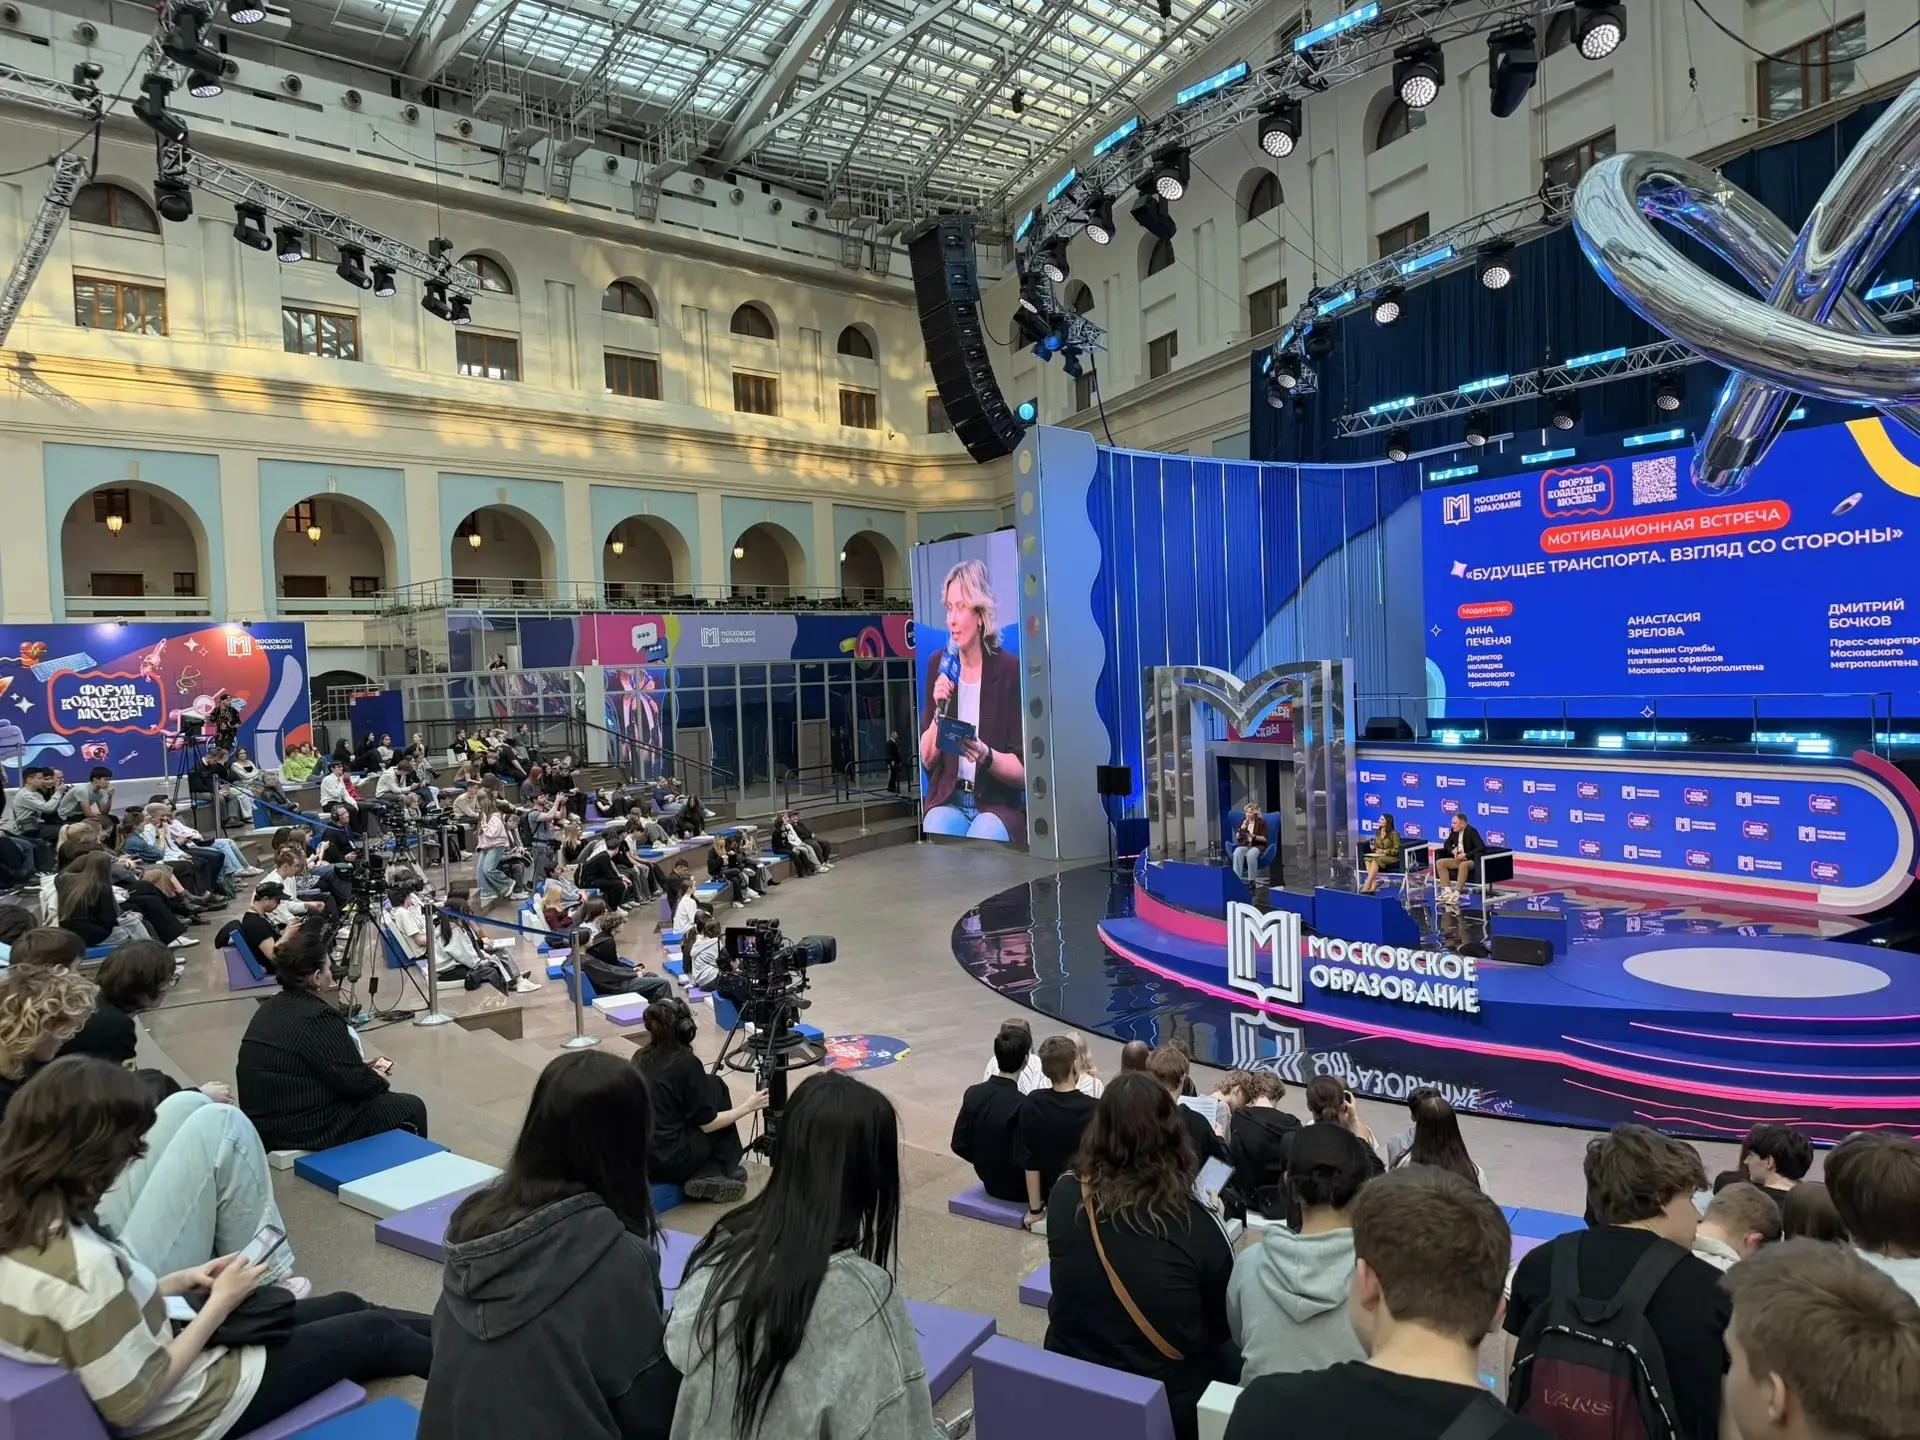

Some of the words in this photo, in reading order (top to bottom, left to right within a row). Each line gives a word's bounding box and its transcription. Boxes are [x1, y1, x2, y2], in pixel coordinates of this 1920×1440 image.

[1559, 476, 1593, 488] ФОРУМ
[1548, 481, 1606, 499] КОЛЛЕДЖЕЙ
[1474, 491, 1521, 505] МОСКОВСКОЕ
[1557, 494, 1596, 507] МОСКВЫ
[1474, 501, 1521, 514] ОБРАЗОВАНИЕ
[1547, 517, 1694, 546] МОТИВАЦИОННАЯ
[1700, 508, 1780, 529] ВСТРЕЧА
[1465, 559, 1545, 581] «БУДУЩЕЕ
[1549, 550, 1665, 574] ТРАНСПОРТА.
[1671, 542, 1743, 563] ВЗГЛЯД
[1748, 539, 1775, 554] СО
[1782, 527, 1904, 551] СТОРОНЫ»
[1462, 604, 1508, 615] Модератор:
[1828, 598, 1905, 616] ДМИТРИЙ
[1627, 612, 1701, 626] АНАСТАСИЯ
[1829, 615, 1892, 628] БОЧКОВ
[1465, 625, 1493, 636] АННА
[1627, 626, 1684, 638] ЗРЕЛОВА
[1466, 635, 1512, 647] ПЕЧЕНАЯ
[1830, 637, 1920, 648] Пресс-секретар
[1627, 646, 1676, 655] Начальник
[1677, 644, 1715, 655] Службы
[1830, 648, 1904, 658] Московского
[1467, 653, 1503, 663] Директор
[1628, 656, 1677, 665] платежных
[1679, 654, 1723, 664] сервисов
[1830, 659, 1918, 669] метрополитена
[1467, 662, 1503, 670] колледжа
[1628, 666, 1686, 675] Московского
[1688, 663, 1764, 674] Метрополитена
[1468, 670, 1515, 679] Московского
[1468, 679, 1510, 688] транспорта
[79, 683, 136, 698] ФОРУМ
[61, 693, 155, 711] КОЛЛЕДЖЕЙ
[77, 704, 143, 722] МОСКВЫ
[1308, 935, 1478, 982] МОСКОВСКОЕ
[1310, 965, 1480, 1013] ОБРАЗОВАНИЕ
[1544, 1388, 1612, 1416] VANS
